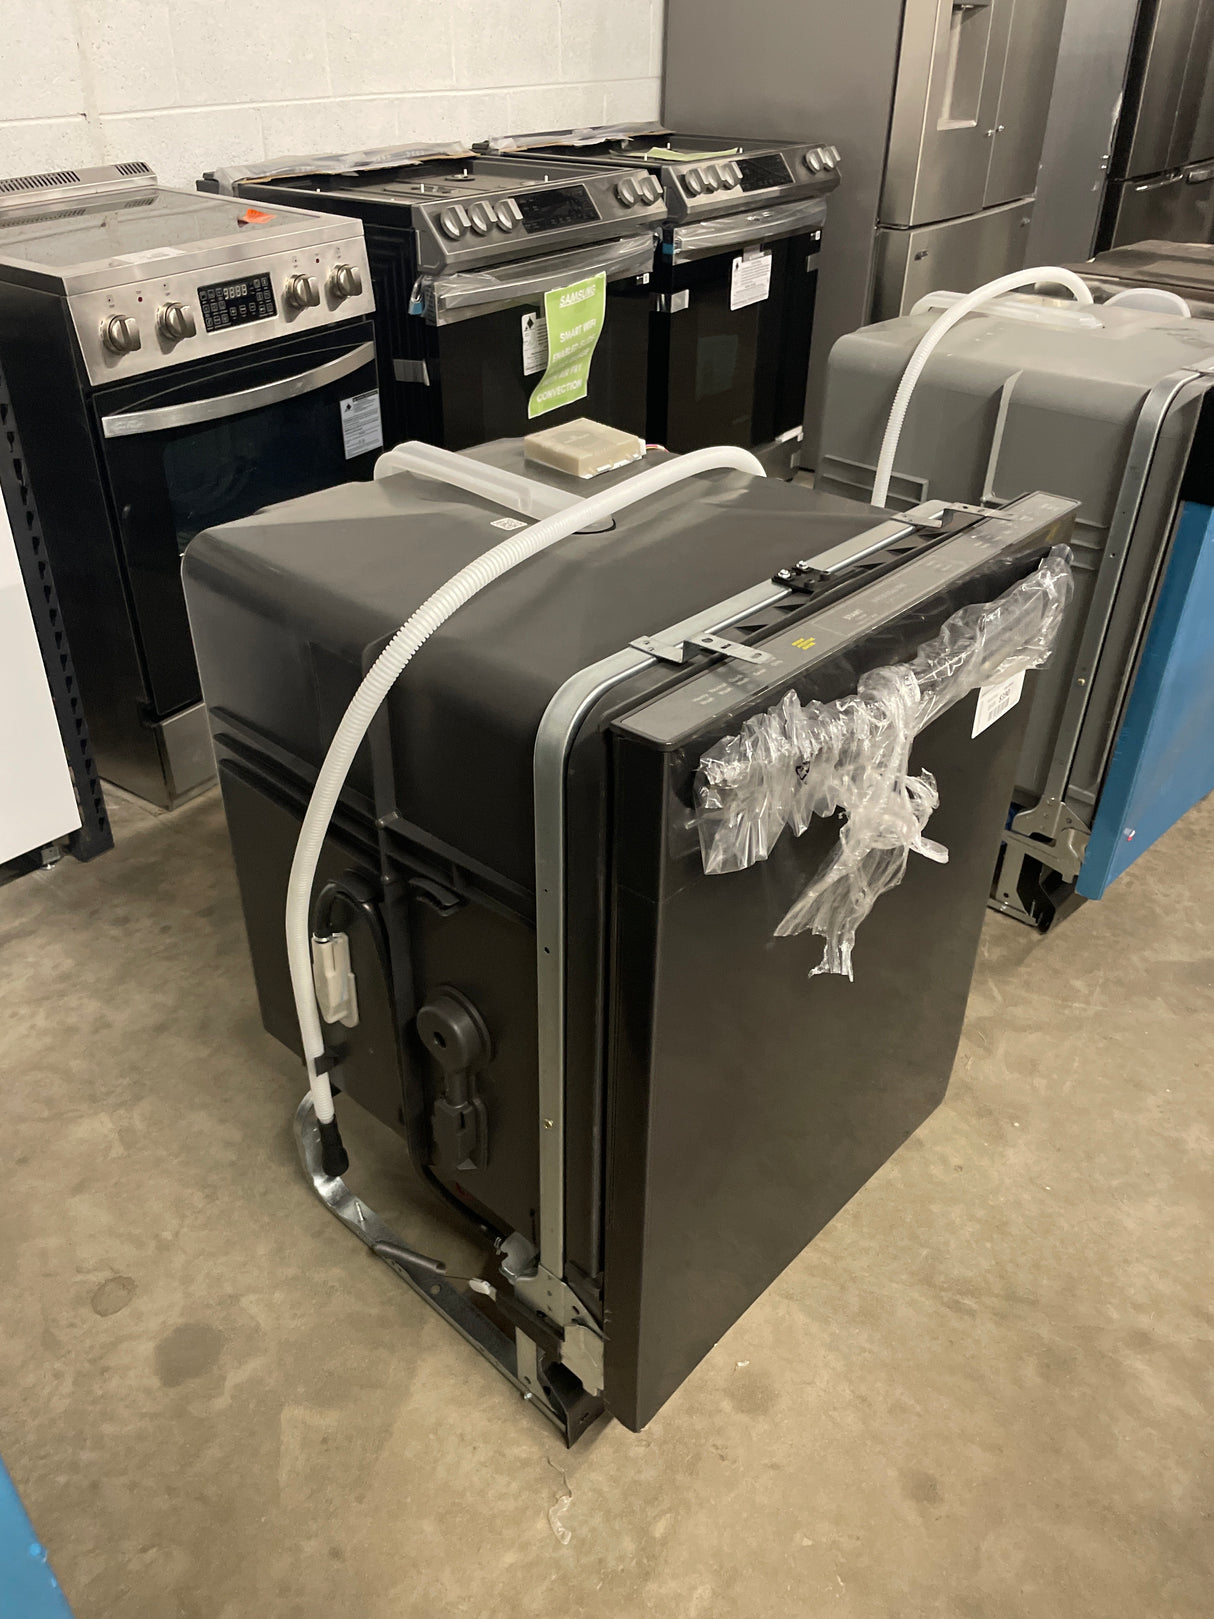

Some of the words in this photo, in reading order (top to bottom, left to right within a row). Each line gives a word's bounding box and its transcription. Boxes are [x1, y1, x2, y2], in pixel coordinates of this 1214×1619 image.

[560, 284, 596, 308] SAMSUNG
[560, 324, 582, 343] SMART
[536, 379, 583, 402] CONVECTION
